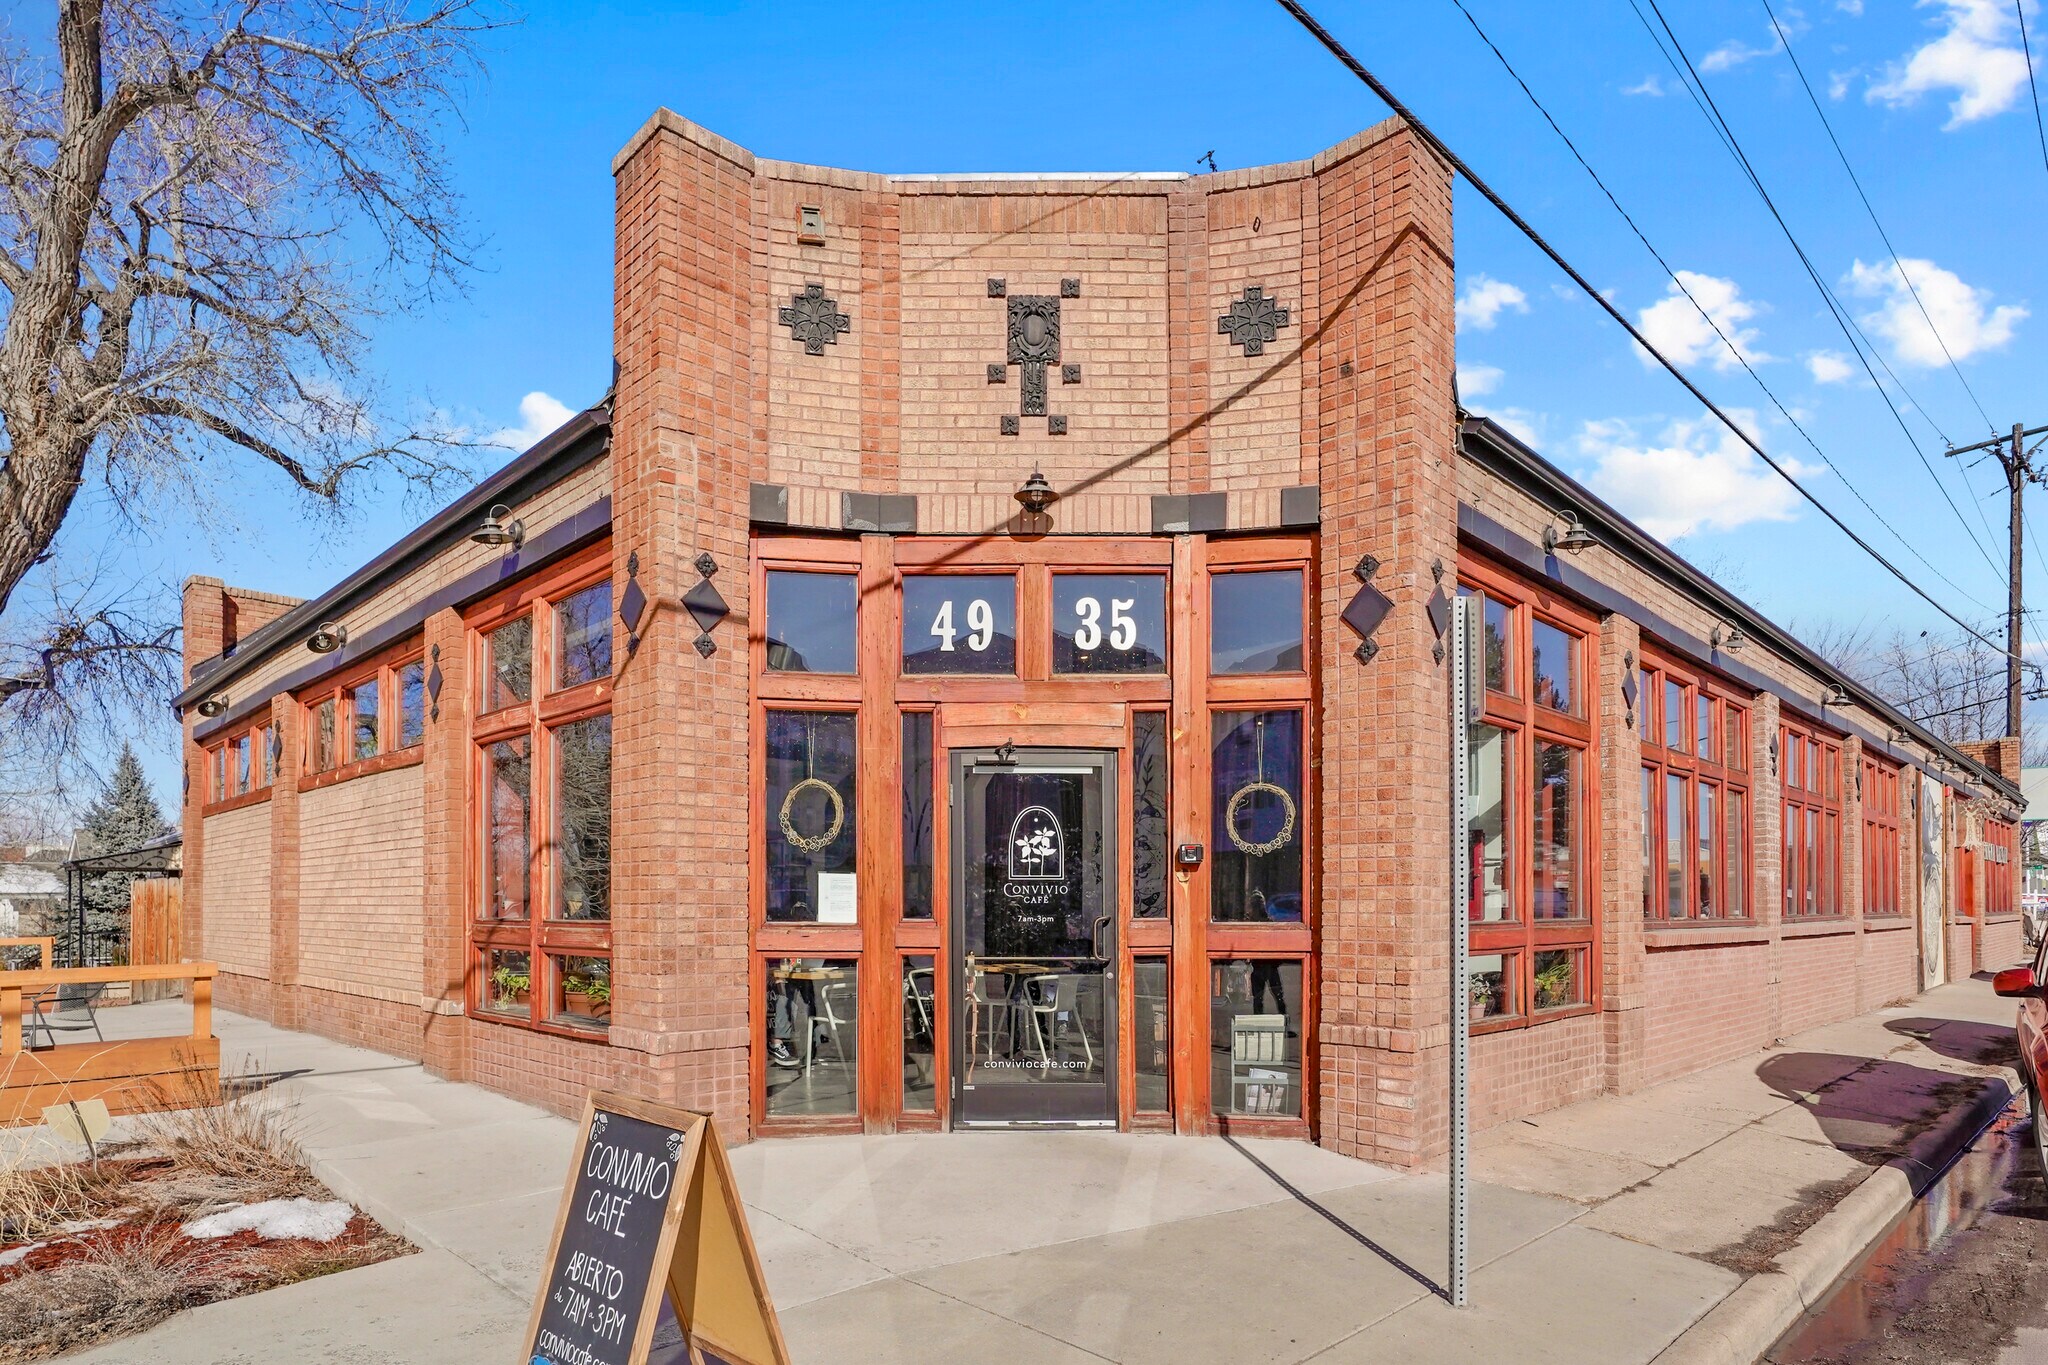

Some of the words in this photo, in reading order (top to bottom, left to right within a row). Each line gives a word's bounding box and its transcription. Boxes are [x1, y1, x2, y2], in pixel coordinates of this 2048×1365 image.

[930, 599, 994, 652] 49
[1074, 596, 1137, 651] 35
[1003, 882, 1069, 898] CONVIVIO
[1023, 894, 1050, 904] CAFÉ
[1017, 914, 1055, 924] 7am-3pm
[983, 1058, 1087, 1069] conviviocafe.com
[587, 1141, 670, 1200] CONVIVIO
[586, 1189, 633, 1238] CAFÉ
[564, 1250, 624, 1300] ABIERTO
[562, 1286, 591, 1327] 7AM
[592, 1304, 627, 1345] 3PM
